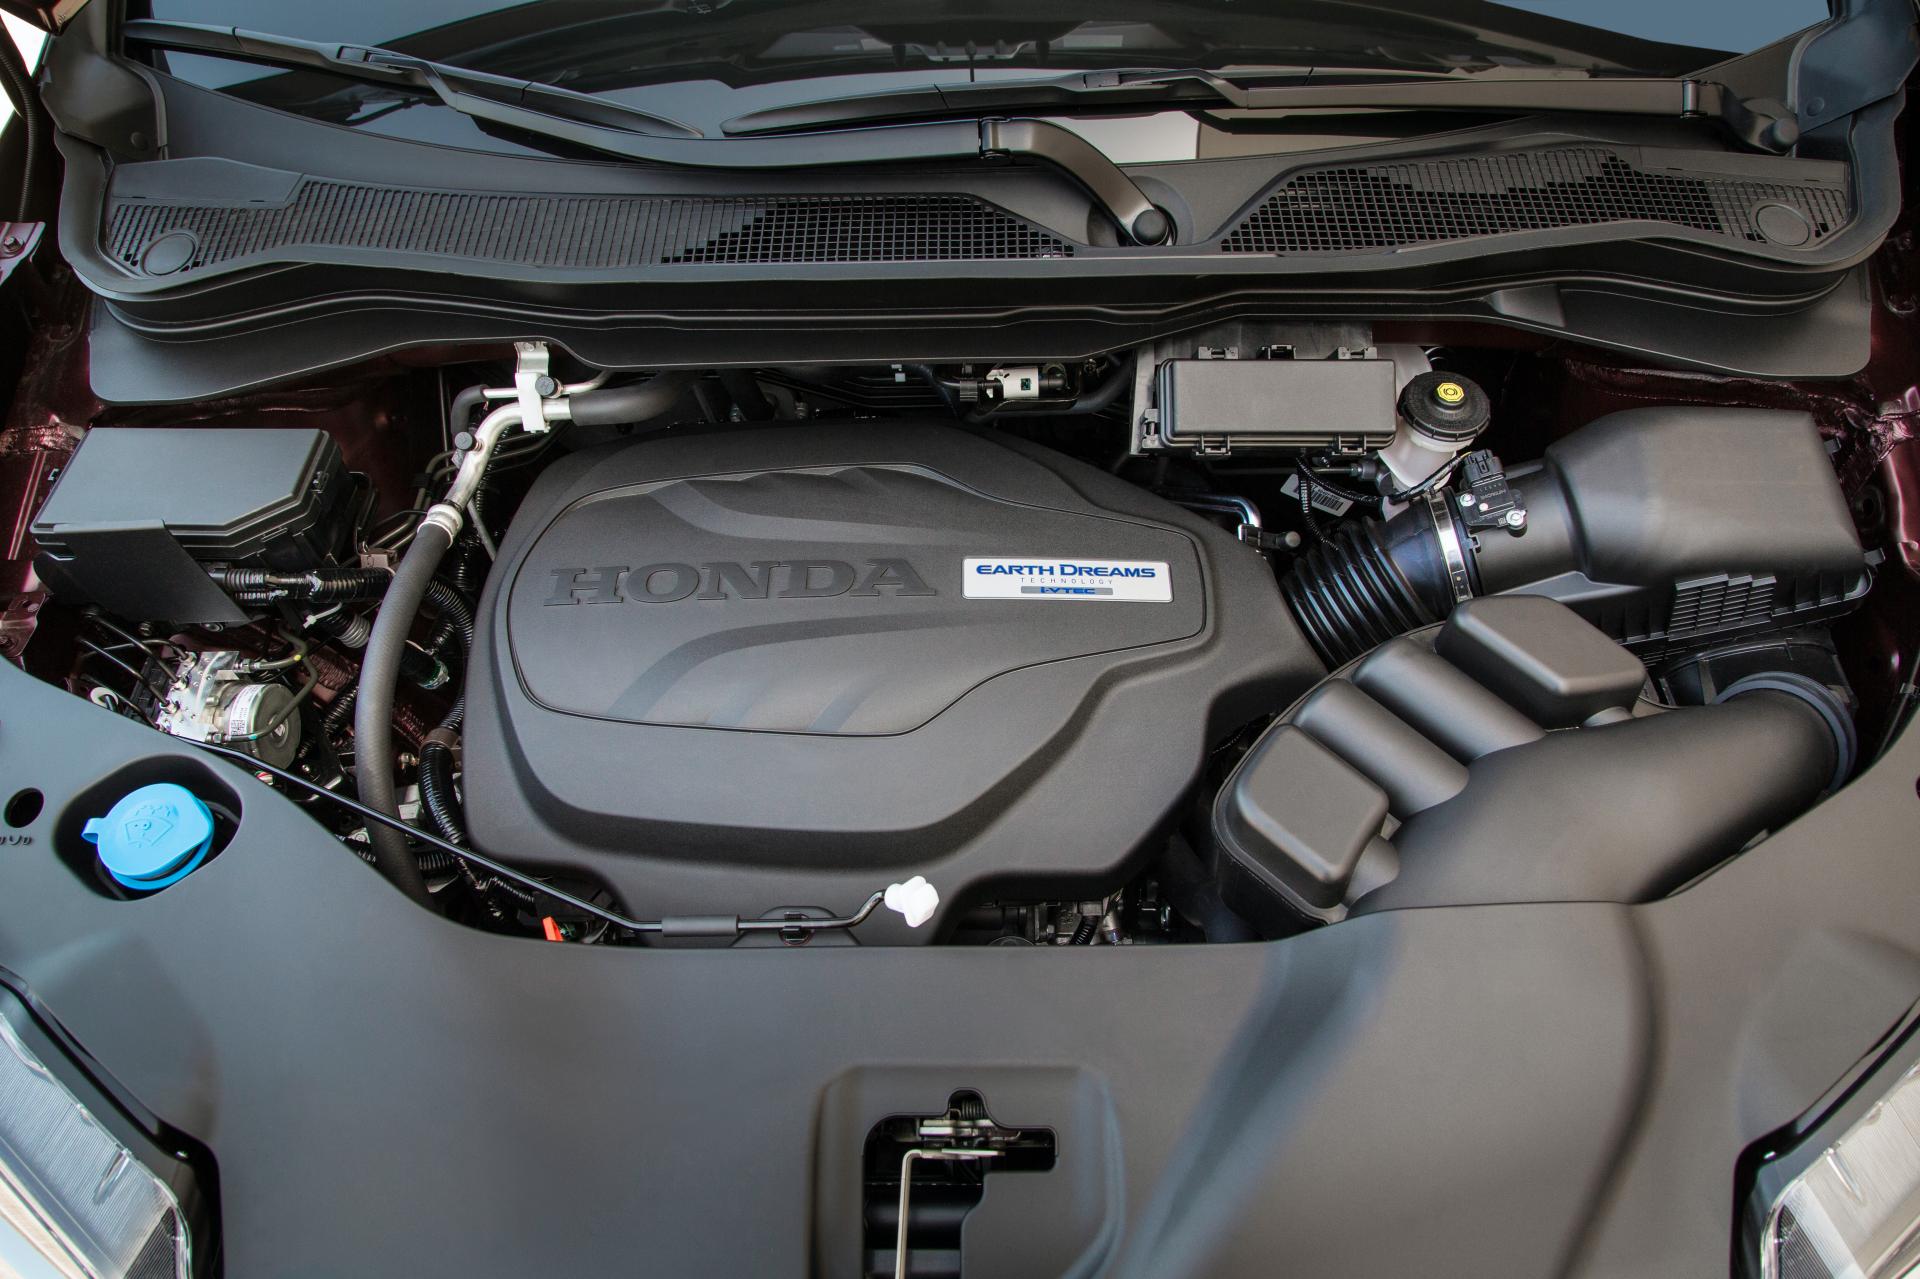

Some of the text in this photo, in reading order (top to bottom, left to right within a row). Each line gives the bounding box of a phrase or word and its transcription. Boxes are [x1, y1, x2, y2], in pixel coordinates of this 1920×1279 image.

[976, 563, 1156, 578] EARTH DREAMS
[543, 557, 937, 607] HONDA
[1020, 577, 1113, 585] TECHNOLOGY
